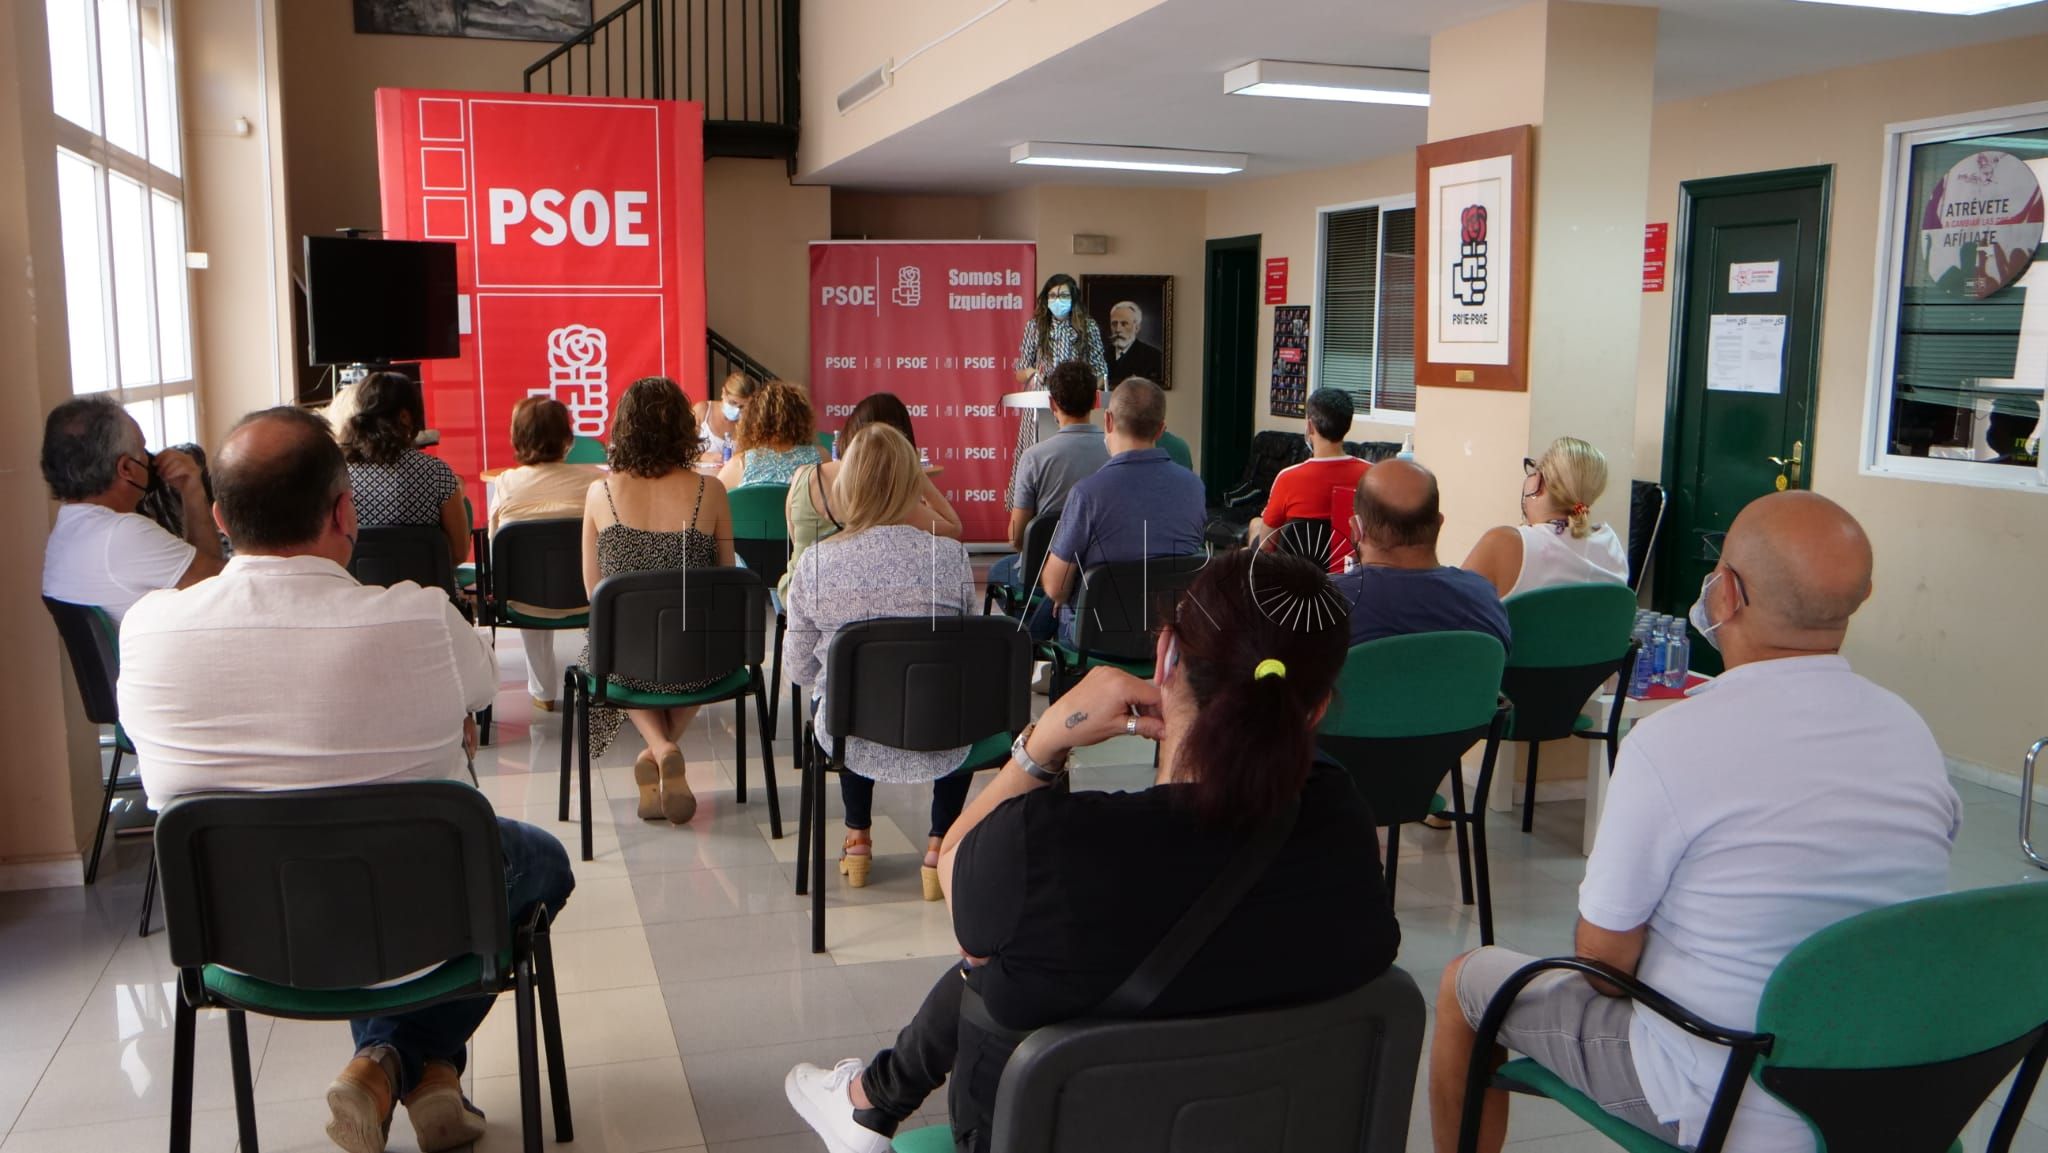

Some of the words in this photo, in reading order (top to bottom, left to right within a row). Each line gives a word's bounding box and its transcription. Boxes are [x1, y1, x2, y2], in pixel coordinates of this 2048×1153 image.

[1946, 198, 2010, 217] ATRÉVETE
[488, 188, 650, 247] PSOE
[1944, 229, 1998, 247] AFÍLIATE
[948, 268, 1002, 287] Somos
[1005, 269, 1021, 286] la
[821, 285, 876, 306] PSOE
[948, 292, 1023, 311] izquierda
[825, 356, 857, 369] PSOE
[896, 356, 928, 369] PSOE
[964, 356, 996, 369] PSOE
[907, 404, 928, 417] SOE
[964, 404, 996, 417] PSOE
[964, 447, 997, 460] PSOE
[964, 489, 997, 502] PSOE
